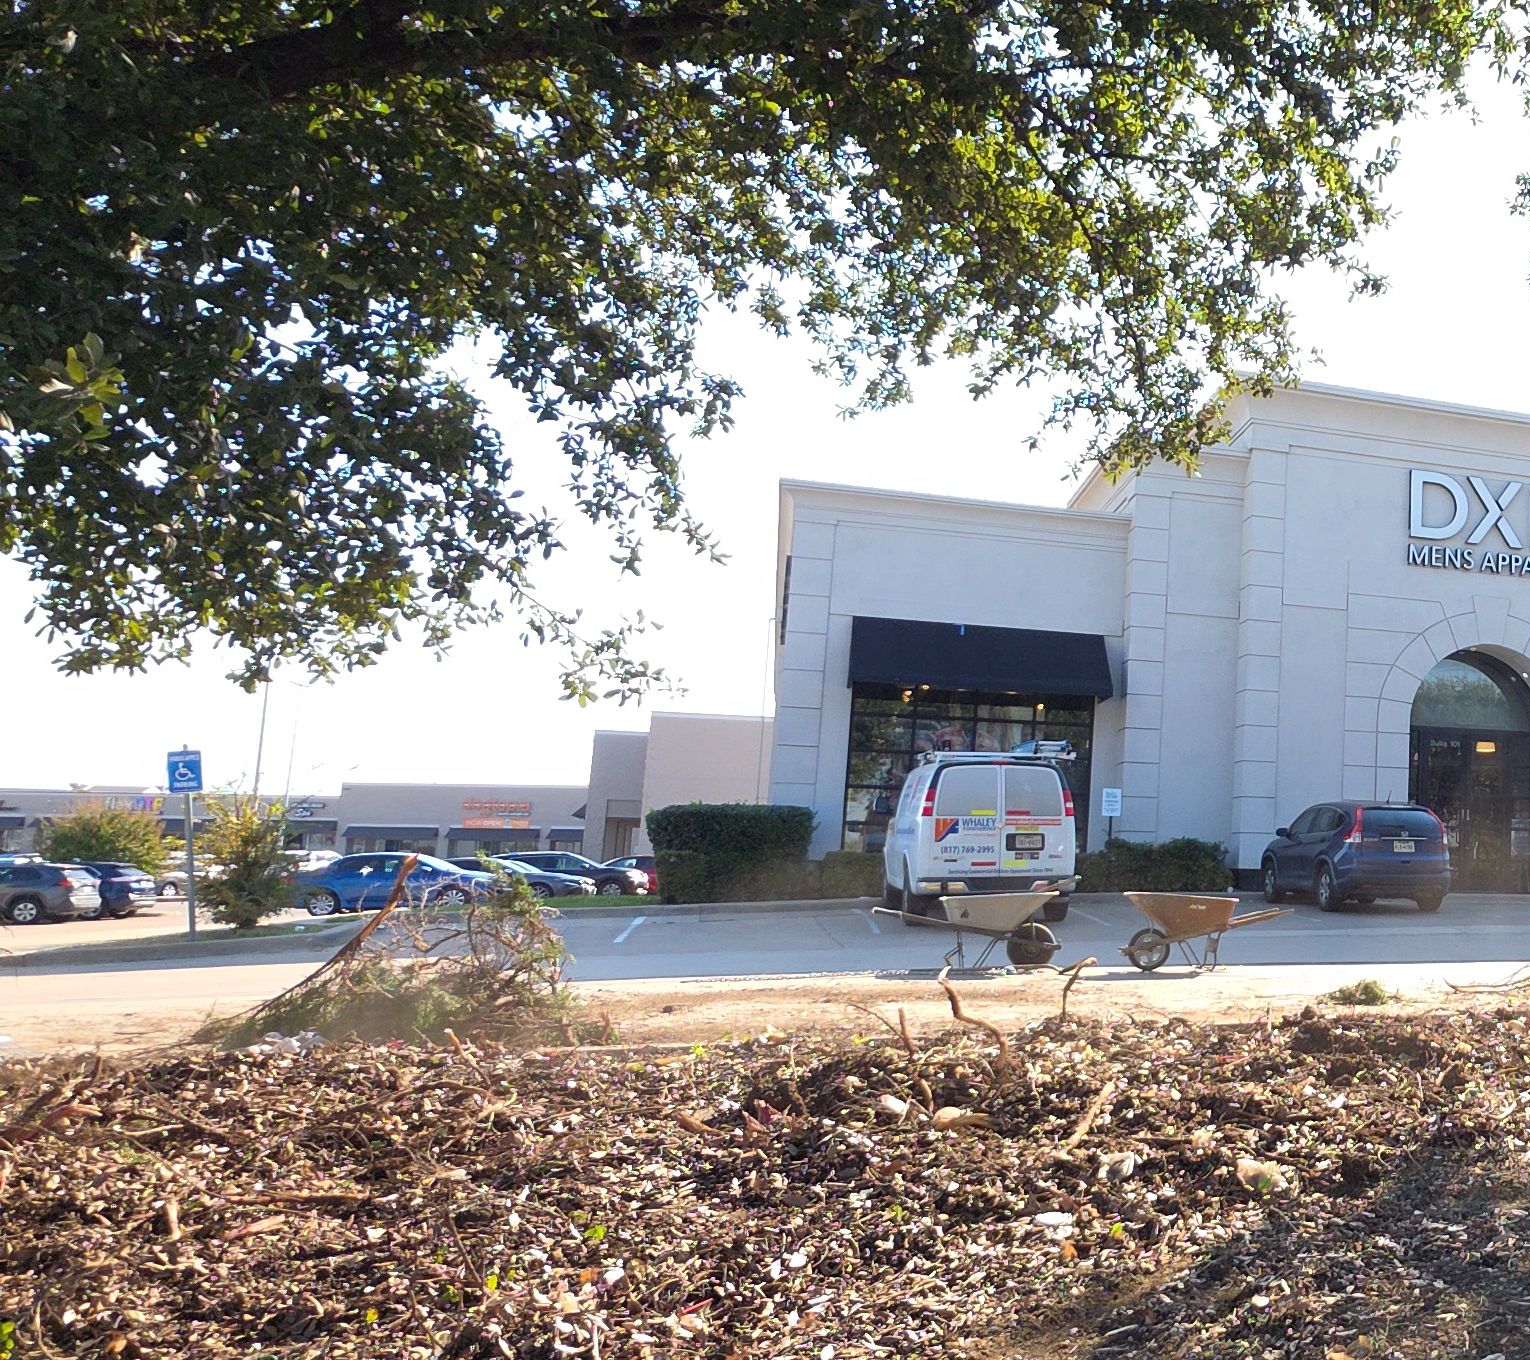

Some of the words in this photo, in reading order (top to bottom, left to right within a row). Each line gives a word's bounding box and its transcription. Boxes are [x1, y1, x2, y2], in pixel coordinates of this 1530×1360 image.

[1408, 543, 1476, 571] MENS
[962, 818, 997, 827] WHALEY
[941, 845, 960, 855] (817)
[962, 845, 995, 854] 769-2995
